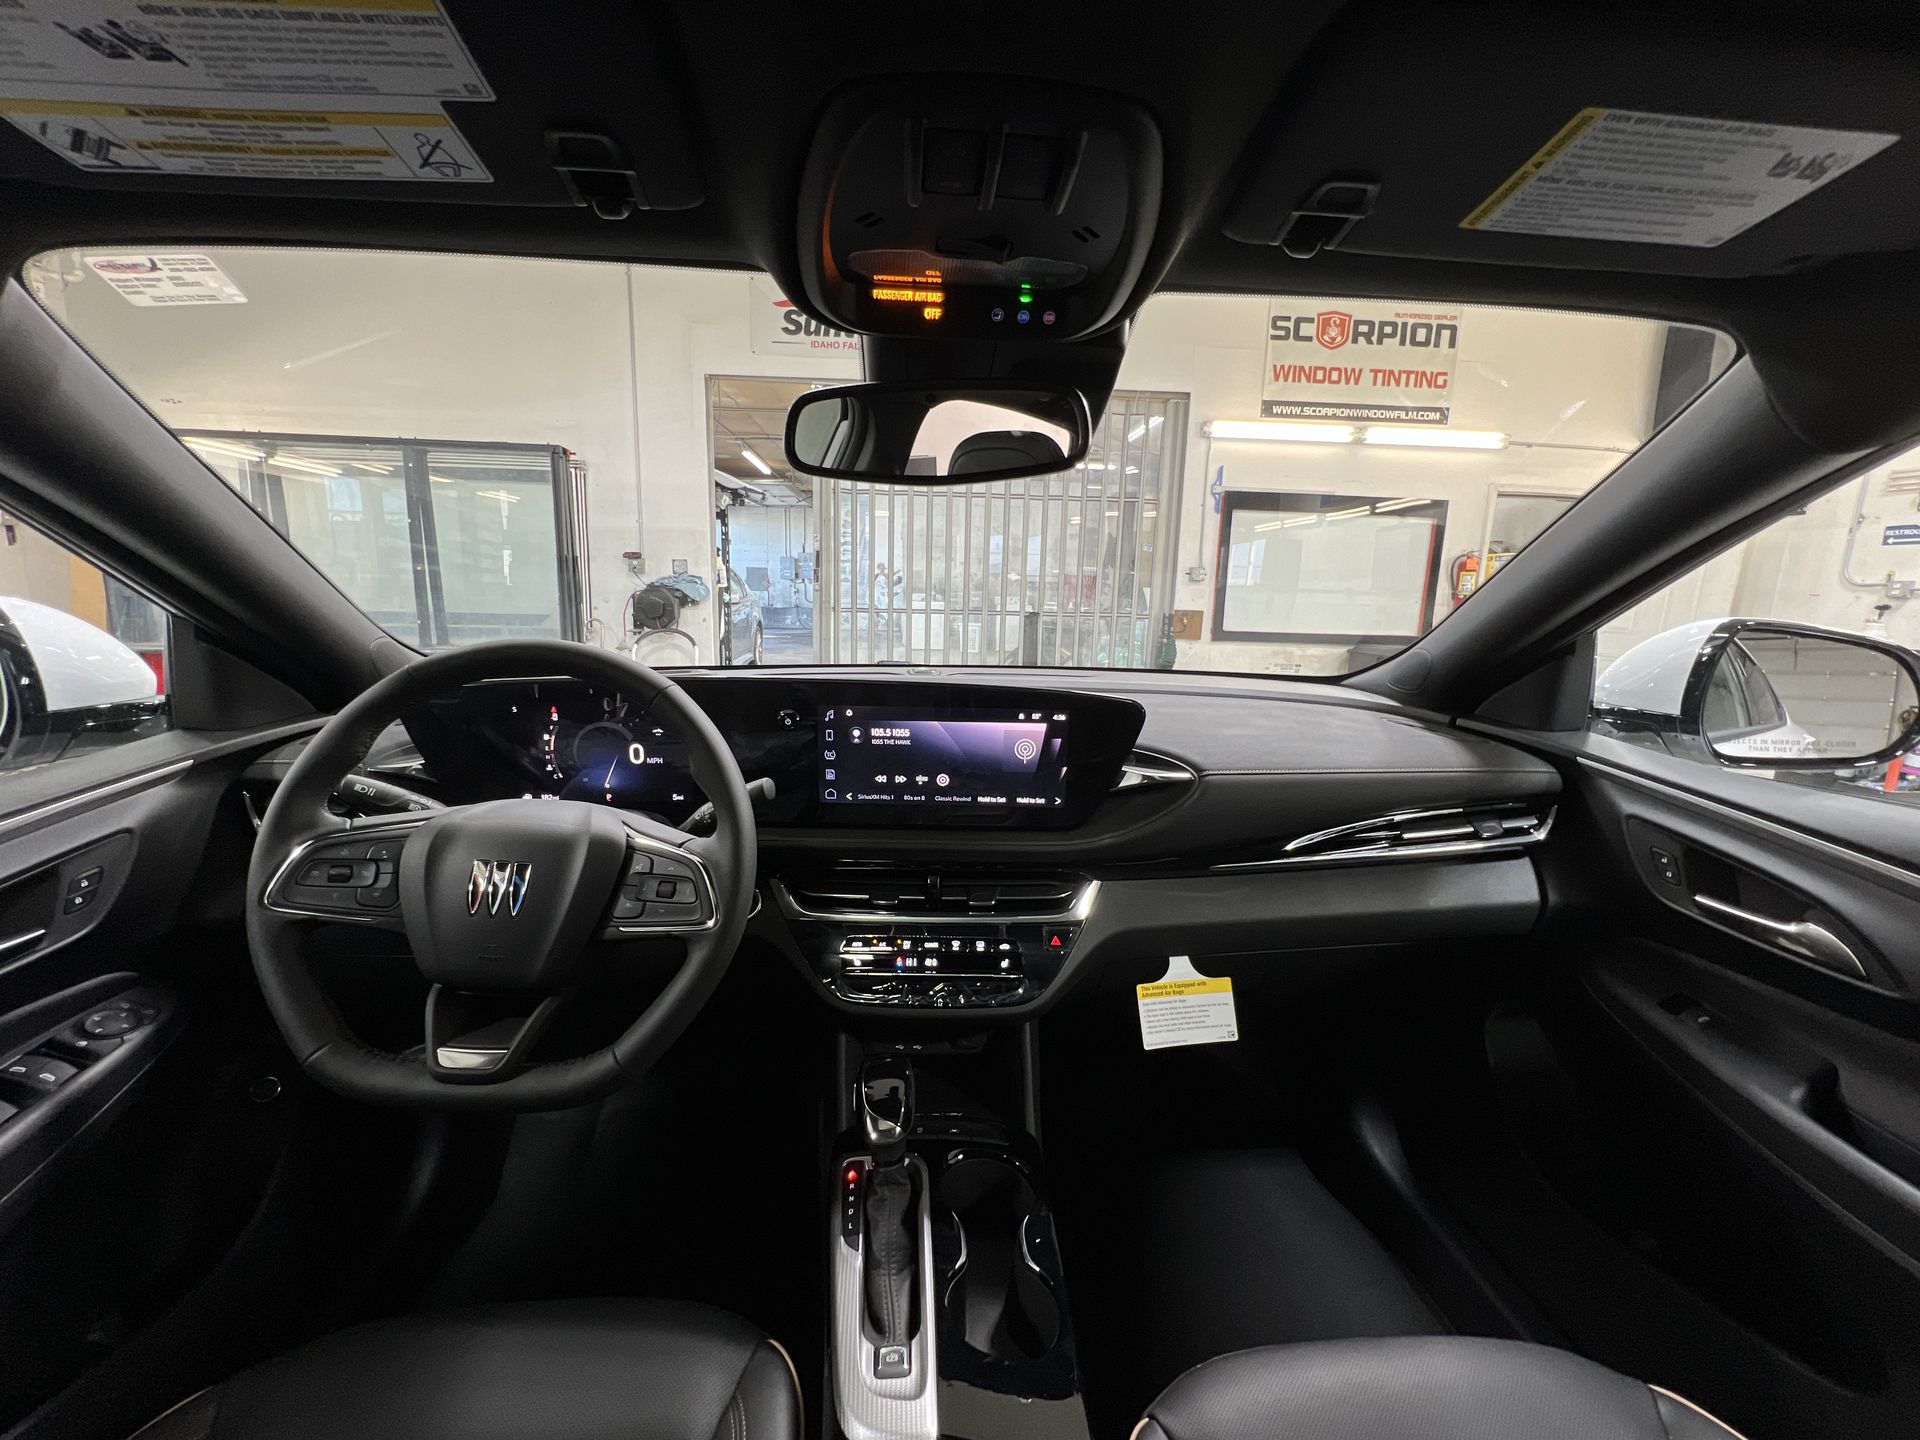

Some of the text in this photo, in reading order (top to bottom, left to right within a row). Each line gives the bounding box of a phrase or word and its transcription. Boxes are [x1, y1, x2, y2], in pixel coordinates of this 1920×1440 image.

[873, 289, 943, 303] PASSENGER AIR BAG
[924, 307, 942, 320] OFF
[1394, 312, 1458, 322] AUTHORIZED DEALER
[810, 340, 860, 351] IDAHO FAL
[1272, 364, 1448, 389] WINDOW TINTING
[1272, 405, 1440, 420] WWW.SCORPIONWINDOWFILM.COM
[871, 728, 910, 737] 105.5 1055
[629, 743, 644, 764] 0
[1142, 990, 1164, 998] Advanced
